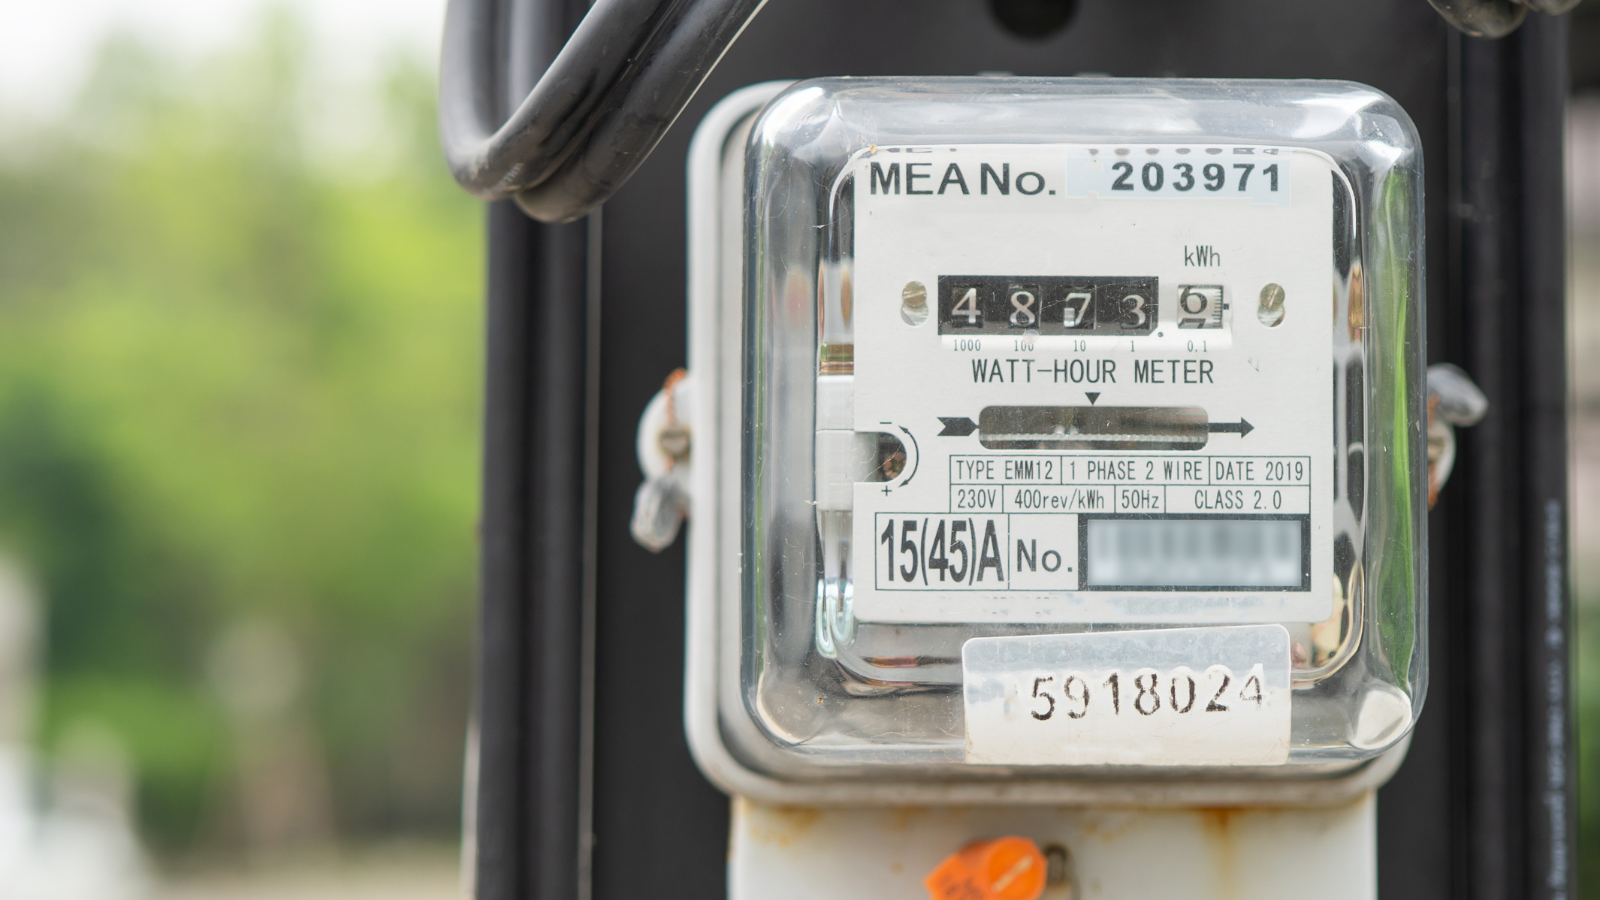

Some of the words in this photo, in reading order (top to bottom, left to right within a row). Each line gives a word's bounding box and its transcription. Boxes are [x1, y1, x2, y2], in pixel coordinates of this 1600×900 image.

[1112, 162, 1278, 191] 203971
[1185, 246, 1220, 266] kWh
[953, 339, 981, 352] 1000
[1073, 340, 1087, 352] 10
[1187, 340, 1208, 352] 0.1
[972, 359, 1116, 383] WATT-HOUR
[1135, 360, 1213, 383] METER
[956, 460, 994, 479] TYPE
[1005, 461, 1052, 479] EMM12
[1069, 461, 1076, 480] 1
[1088, 461, 1135, 480] PHASE
[1145, 461, 1154, 480] 2
[1164, 461, 1202, 480] WIRE
[1216, 461, 1254, 480] DATE
[1266, 462, 1303, 480] 2019
[958, 489, 996, 508] 230V
[1015, 489, 1104, 509] 400rev/kWh
[1122, 490, 1159, 508] 50Hz
[1195, 490, 1243, 509] CLASS
[1254, 490, 1281, 509] 2.0
[881, 518, 1004, 586] 15(45)A
[1017, 539, 1072, 572] No.
[1031, 671, 1265, 721] 5918024
